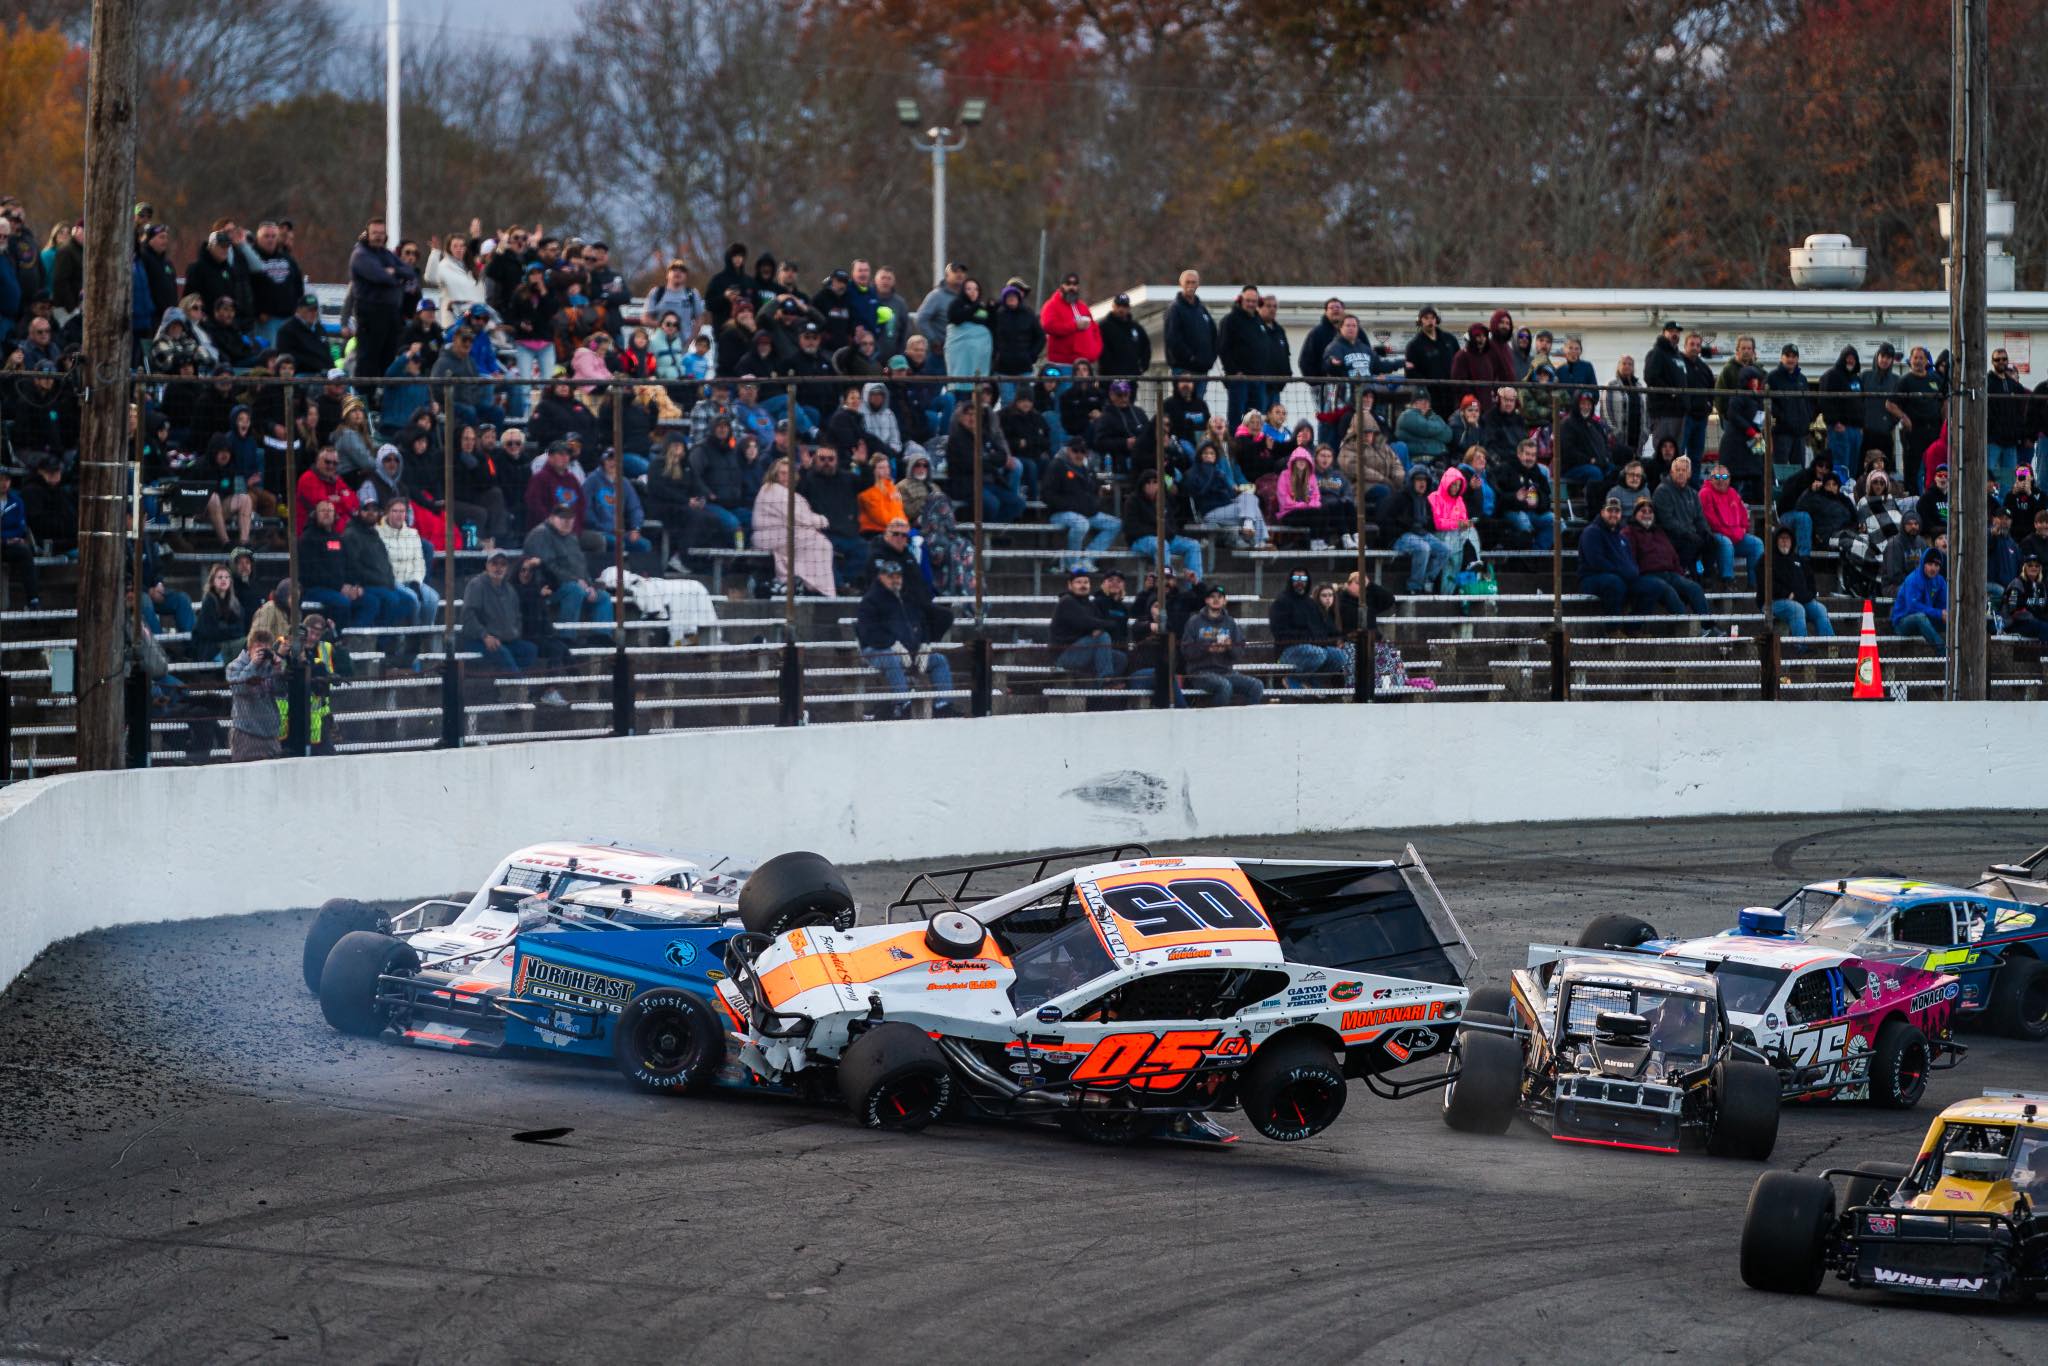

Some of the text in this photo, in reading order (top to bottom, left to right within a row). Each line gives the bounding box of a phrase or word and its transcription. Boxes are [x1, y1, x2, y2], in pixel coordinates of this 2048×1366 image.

[526, 957, 633, 1002] NORTHEAST
[1287, 985, 1327, 996] GATOR
[1290, 993, 1324, 1002] SPORT
[532, 986, 624, 1014] DRILLING
[640, 997, 694, 1015] Hoosier
[1287, 998, 1327, 1007] FISHING
[1910, 986, 1945, 1014] MONACO
[1340, 1004, 1427, 1031] MONTANARI
[1070, 1029, 1222, 1093] 05
[1604, 1059, 1634, 1068] Airgas
[635, 1069, 689, 1087] Hoosier
[1290, 1068, 1338, 1087] Hoosier
[930, 1074, 951, 1118] Hoosier
[1264, 1124, 1311, 1141] Hoosier
[1945, 1189, 1975, 1201] 31
[1874, 1267, 1983, 1289] WHELEN
